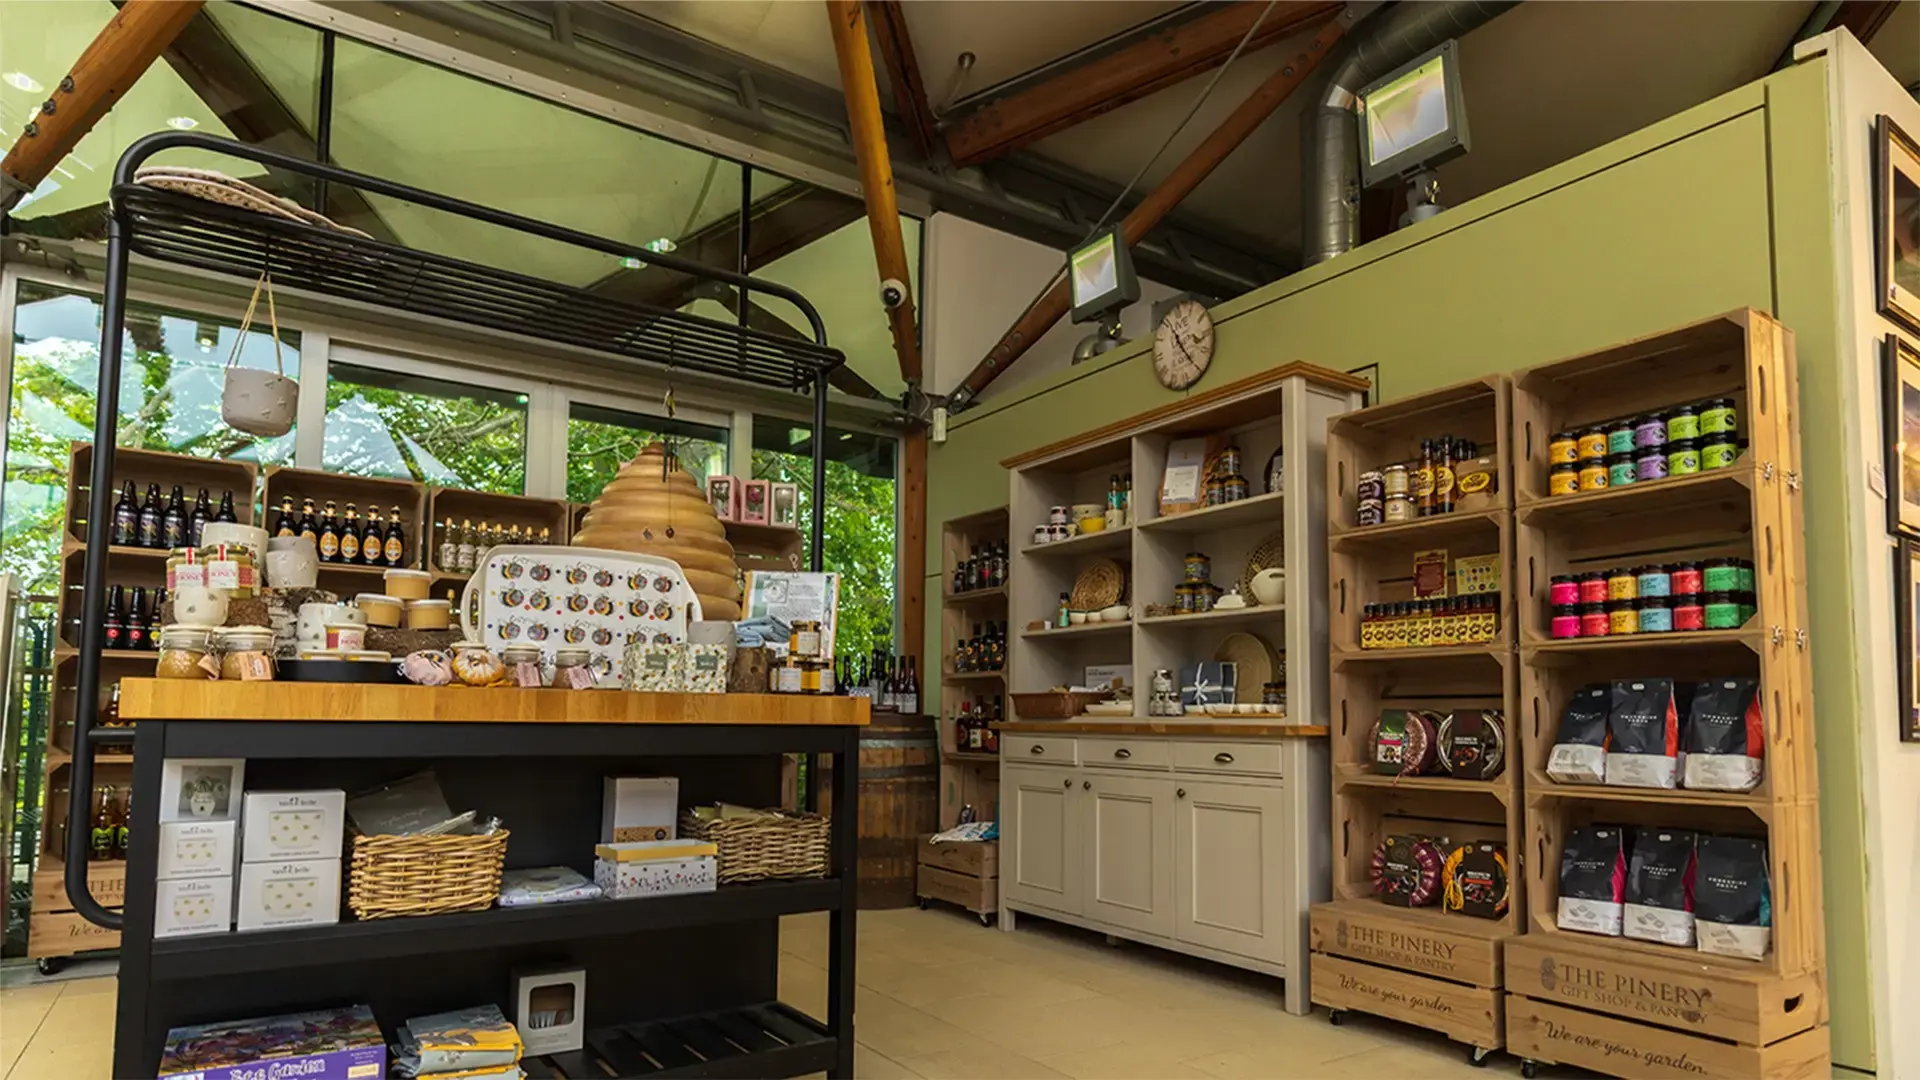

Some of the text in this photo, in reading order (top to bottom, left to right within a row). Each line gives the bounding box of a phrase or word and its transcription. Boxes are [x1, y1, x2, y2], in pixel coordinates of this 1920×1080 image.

[1351, 925, 1457, 959] THE PINERY
[1351, 943, 1456, 973] GIFT SHOP & PANTRY
[1338, 974, 1360, 991] We
[1360, 985, 1379, 996] are
[1381, 989, 1406, 1003] your
[1560, 963, 1709, 1008] THE PINERY
[1561, 985, 1590, 1000] GIFT
[1594, 992, 1632, 1008] SHOP
[1635, 1001, 1648, 1013] &
[1544, 1021, 1708, 1075] We are your garden.
